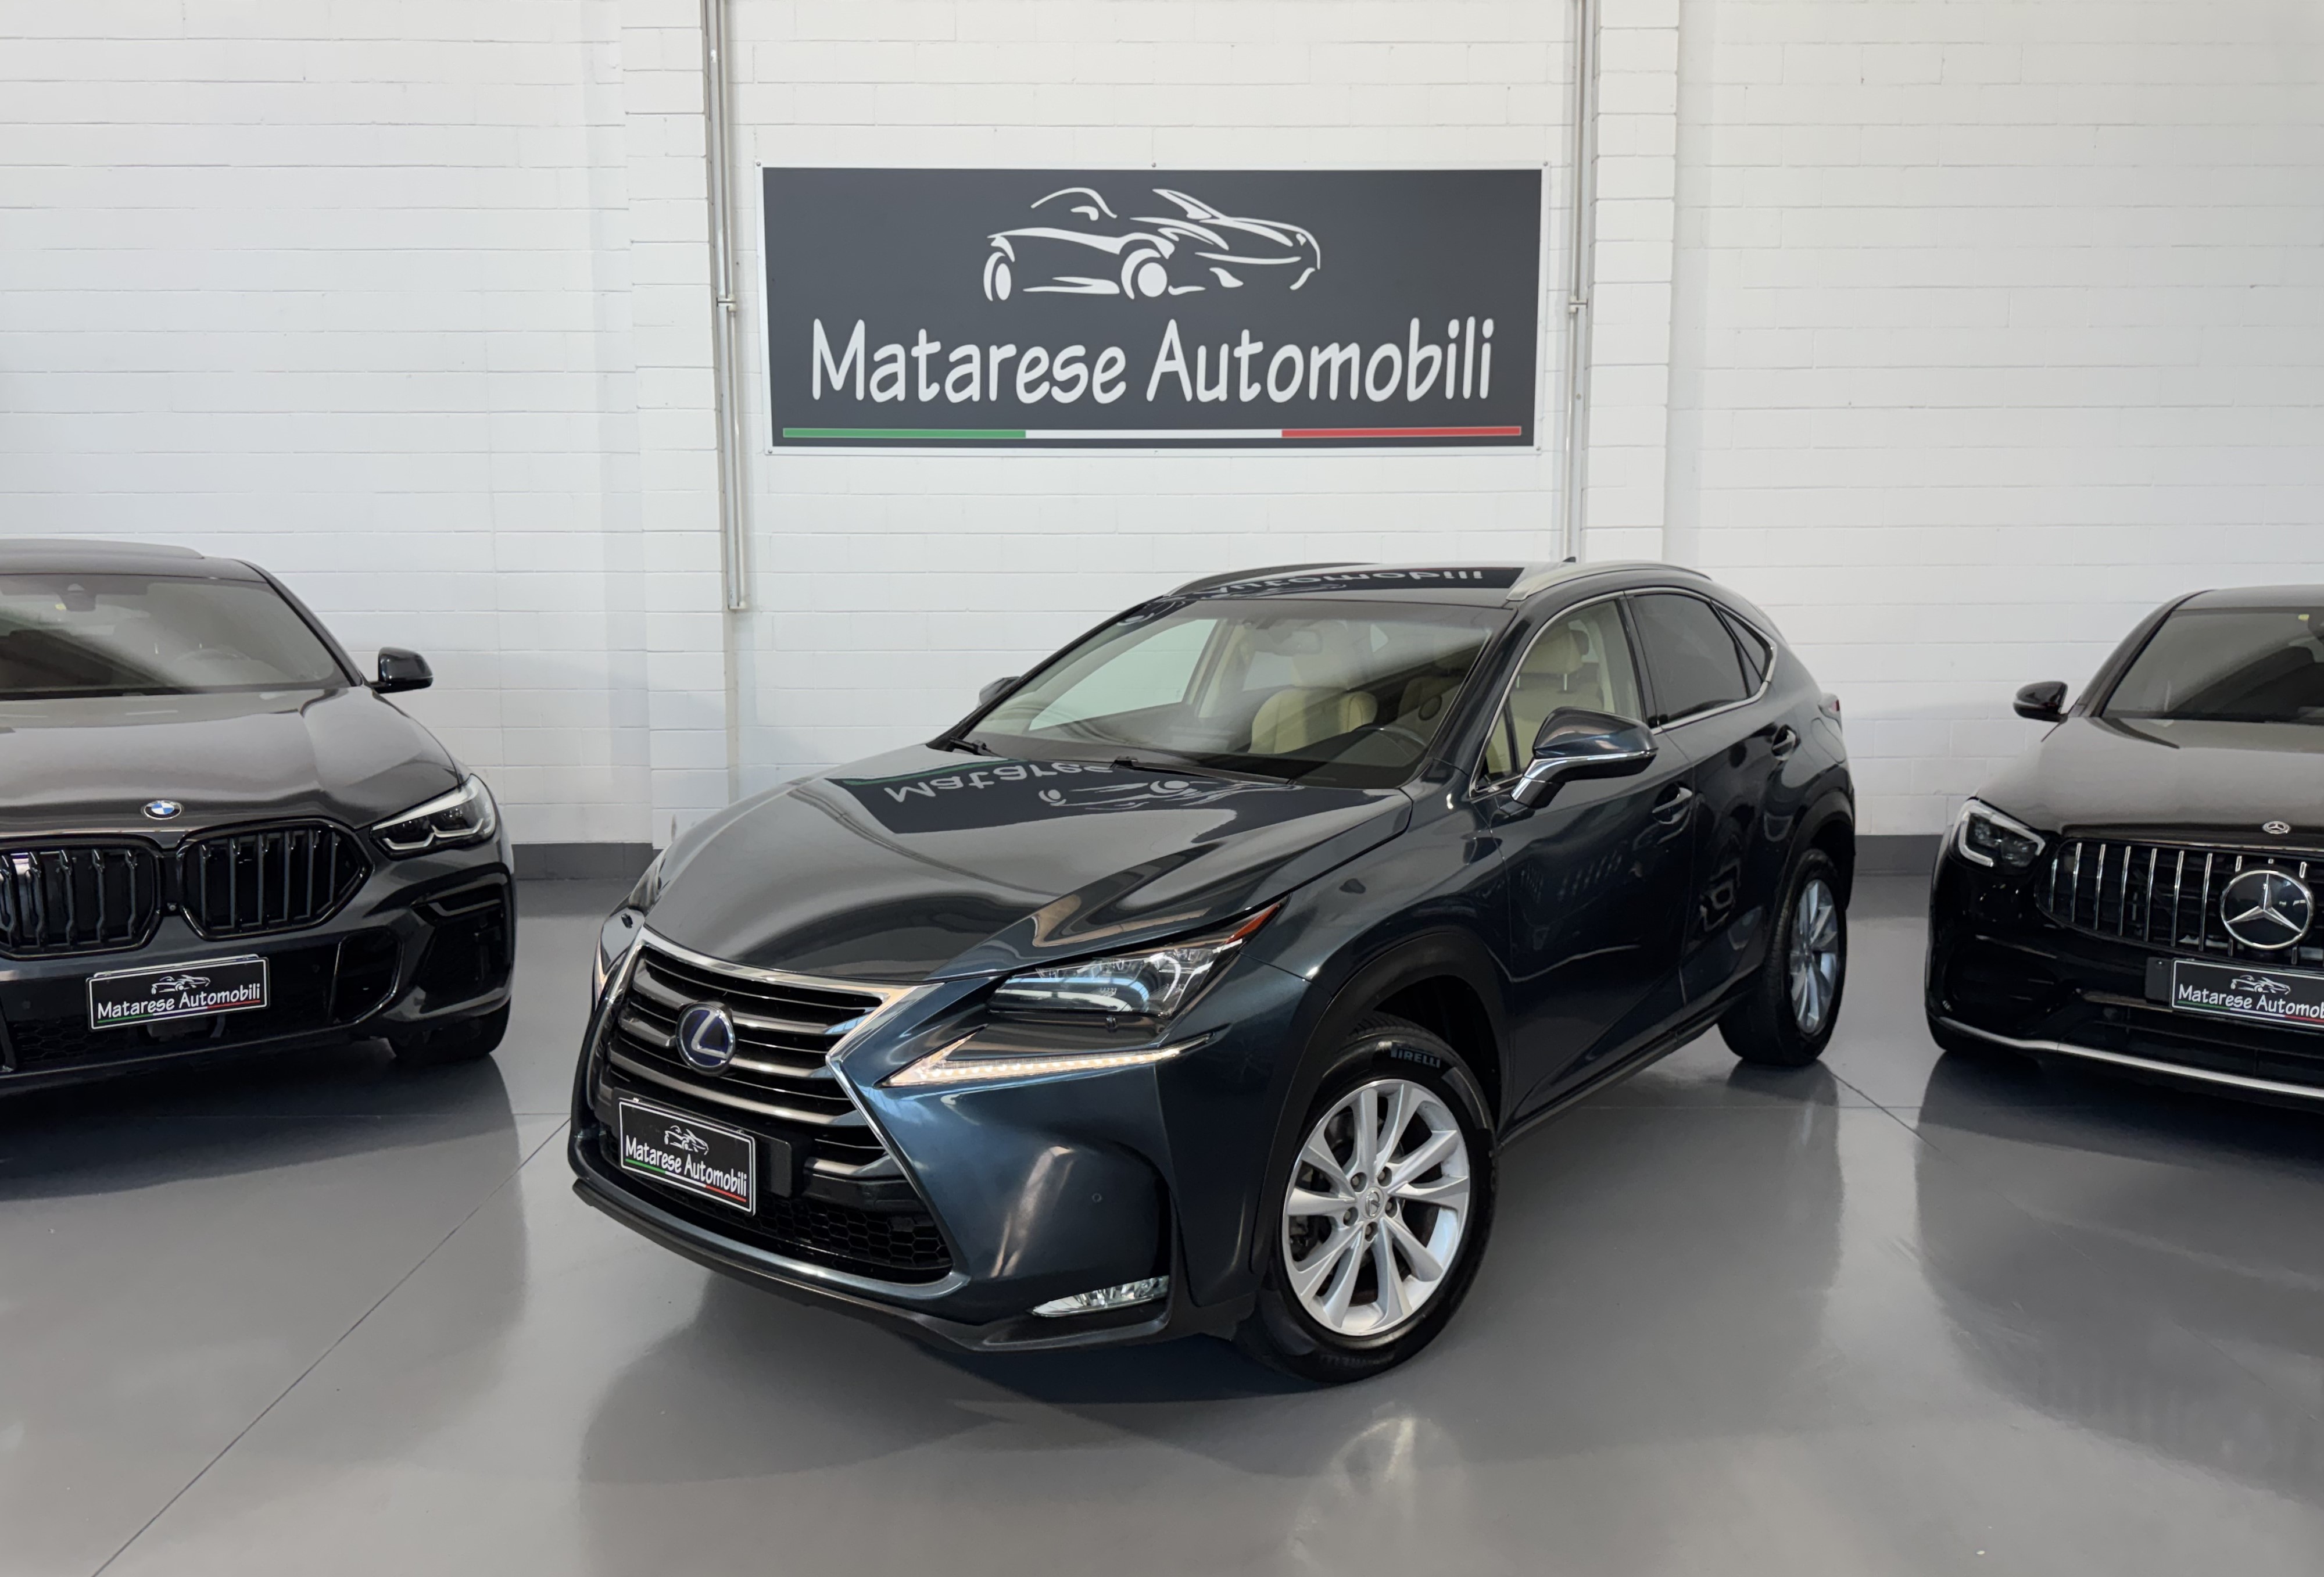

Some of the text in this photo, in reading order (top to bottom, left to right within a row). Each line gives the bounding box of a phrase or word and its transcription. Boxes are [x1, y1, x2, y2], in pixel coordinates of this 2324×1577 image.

[811, 316, 1495, 405] Matarese Automobili
[97, 982, 261, 1020] Matarese Automobili
[2178, 983, 2253, 1009] Matarese
[1390, 1044, 1440, 1068] PIRELLI
[625, 1134, 747, 1197] Matarese Automobili
